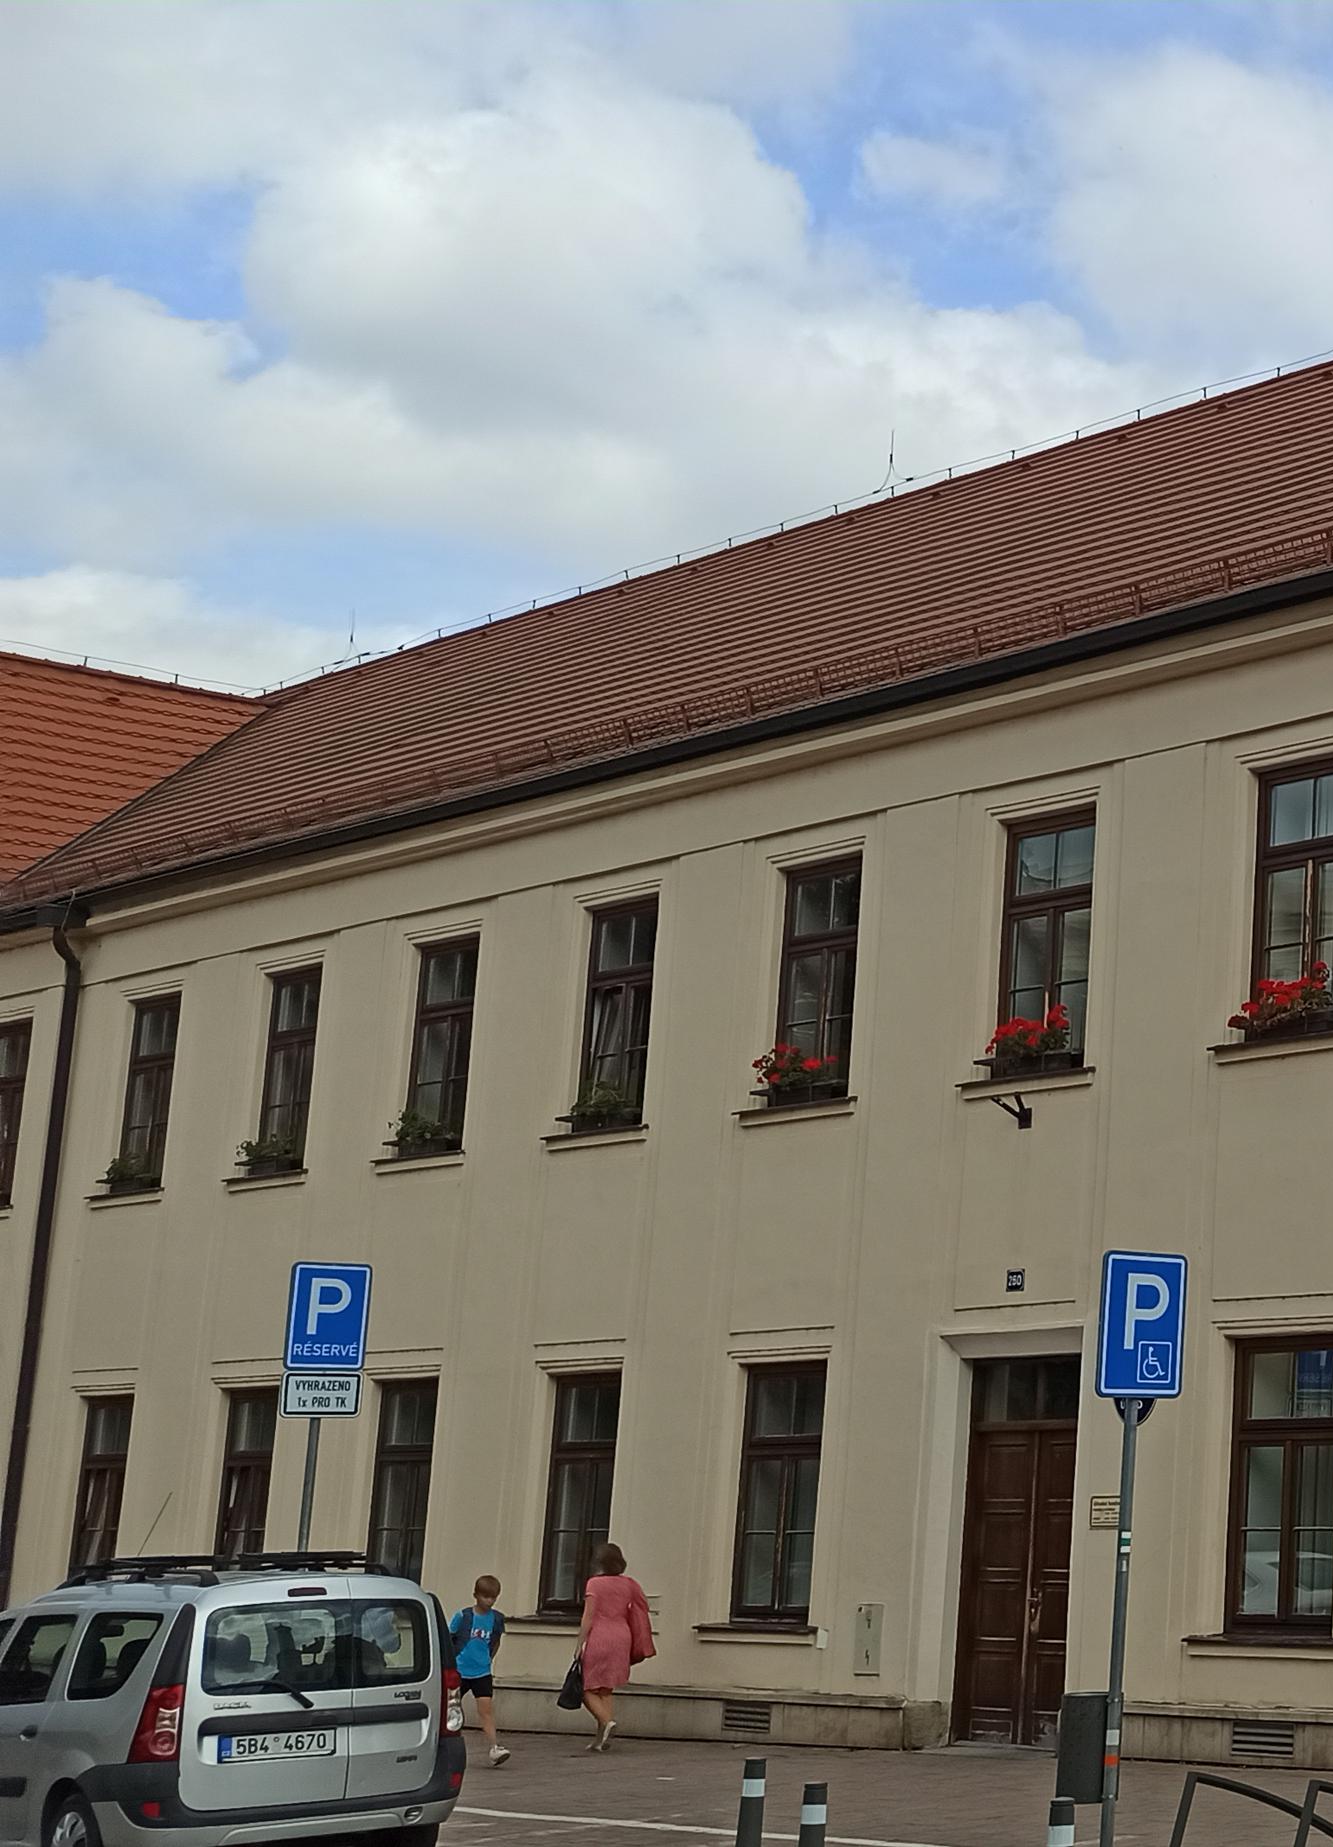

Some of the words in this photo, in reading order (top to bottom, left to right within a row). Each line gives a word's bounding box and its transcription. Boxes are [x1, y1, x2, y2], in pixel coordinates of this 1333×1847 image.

[306, 1277, 352, 1335] P
[1123, 1272, 1170, 1350] P
[293, 1341, 359, 1357] RÉSERVÉ
[295, 1379, 351, 1392] VYHRAZENO
[311, 1396, 331, 1408] PRO
[335, 1396, 347, 1408] TK
[235, 1737, 270, 1755] 5B4
[283, 1732, 327, 1750] 4670
